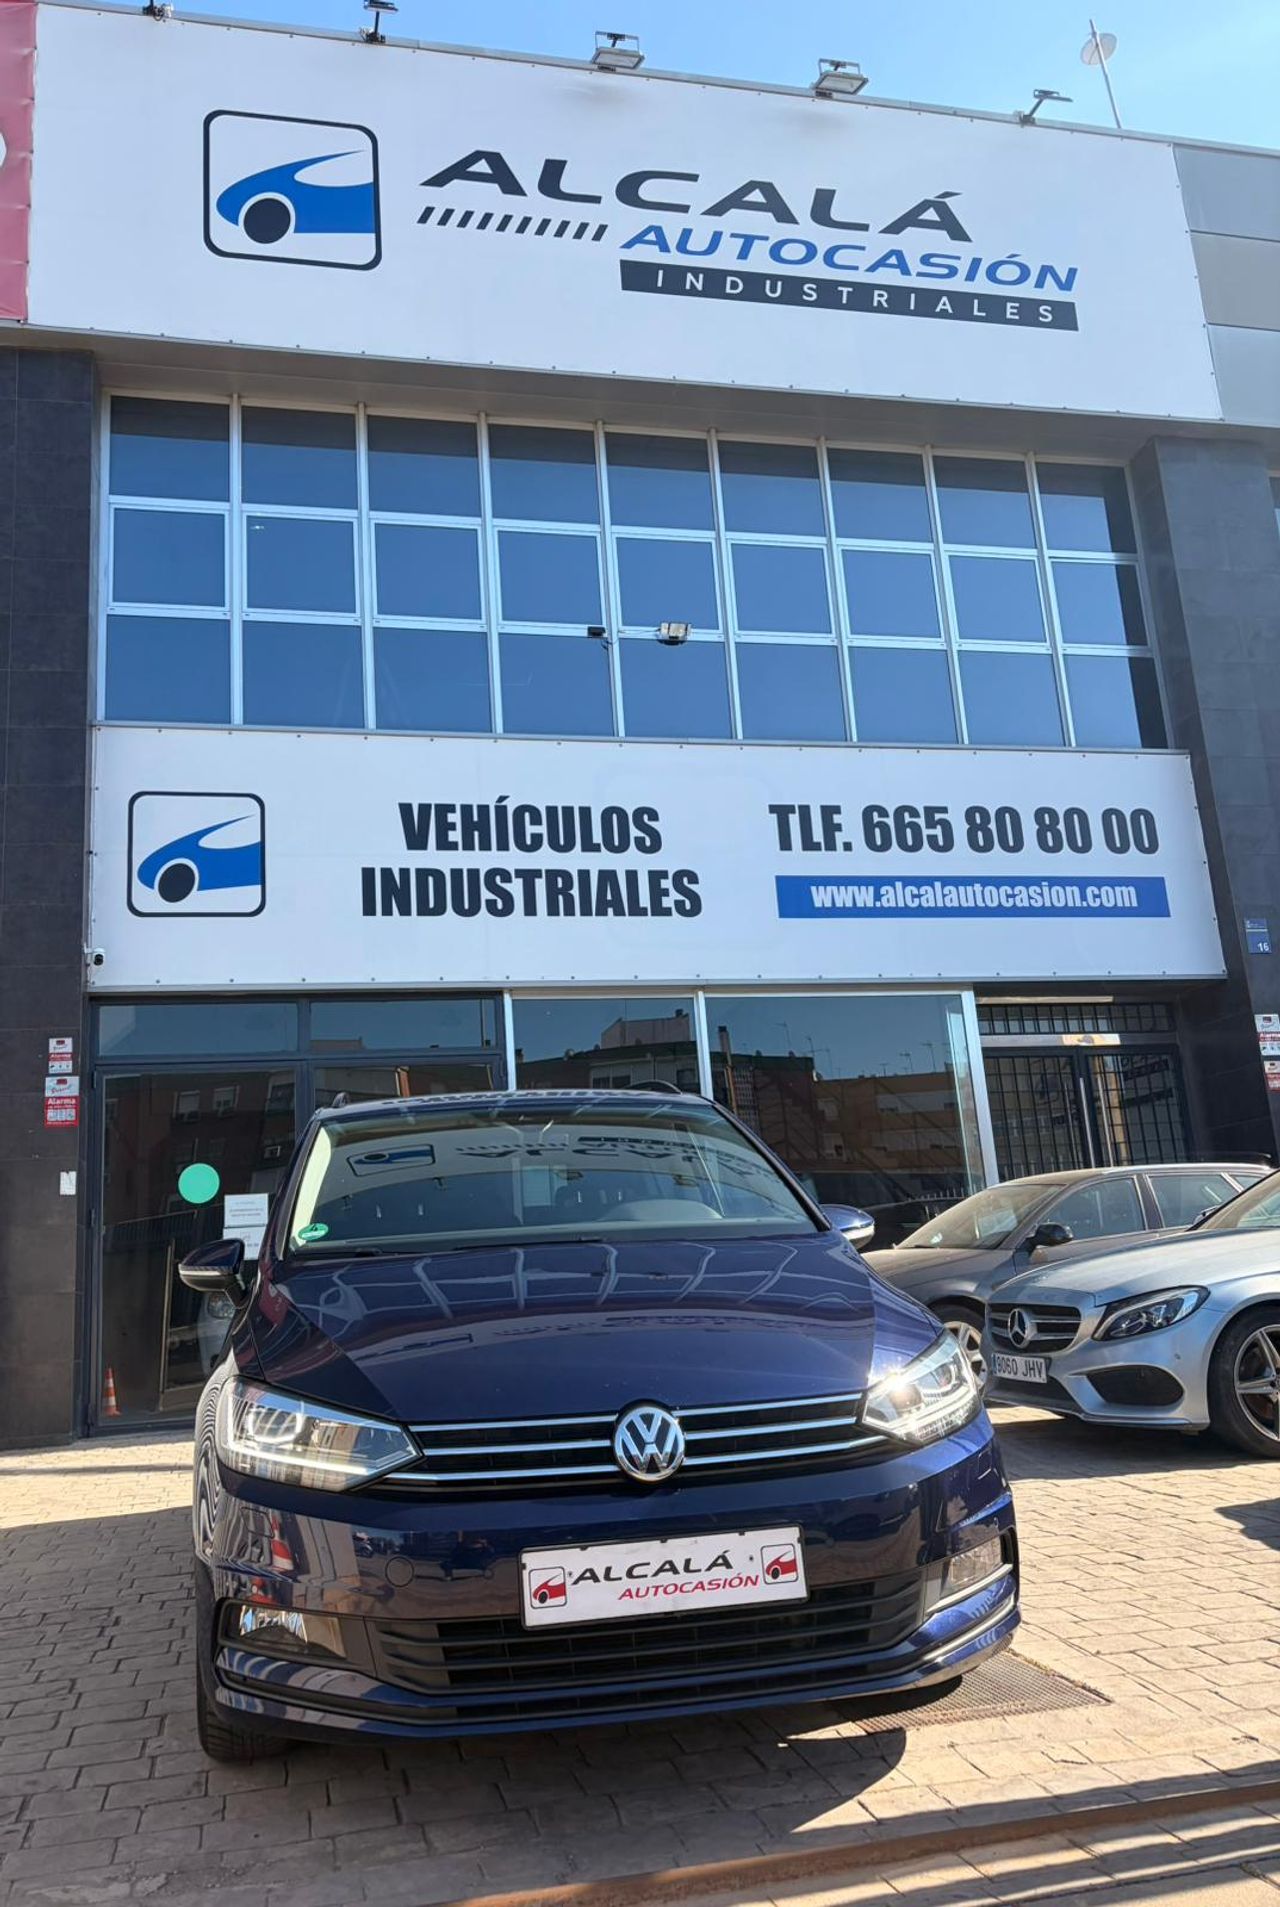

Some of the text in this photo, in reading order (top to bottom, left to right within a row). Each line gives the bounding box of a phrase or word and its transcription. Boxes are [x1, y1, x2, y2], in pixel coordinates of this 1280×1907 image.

[420, 150, 973, 242] ALCALÁ
[619, 224, 1079, 292] AUTOCASIÓN
[656, 268, 1055, 323] INDUSTRIALES
[398, 795, 663, 855] VEHÍCULOS
[768, 804, 1160, 855] TLF. 665 80 80 00
[361, 866, 703, 918] INDUSTRIALES
[810, 881, 1138, 909] www.alcalautocasion.com
[570, 1550, 734, 1586] ALCALÁ
[618, 1571, 760, 1601] AUTOCASIÓN
